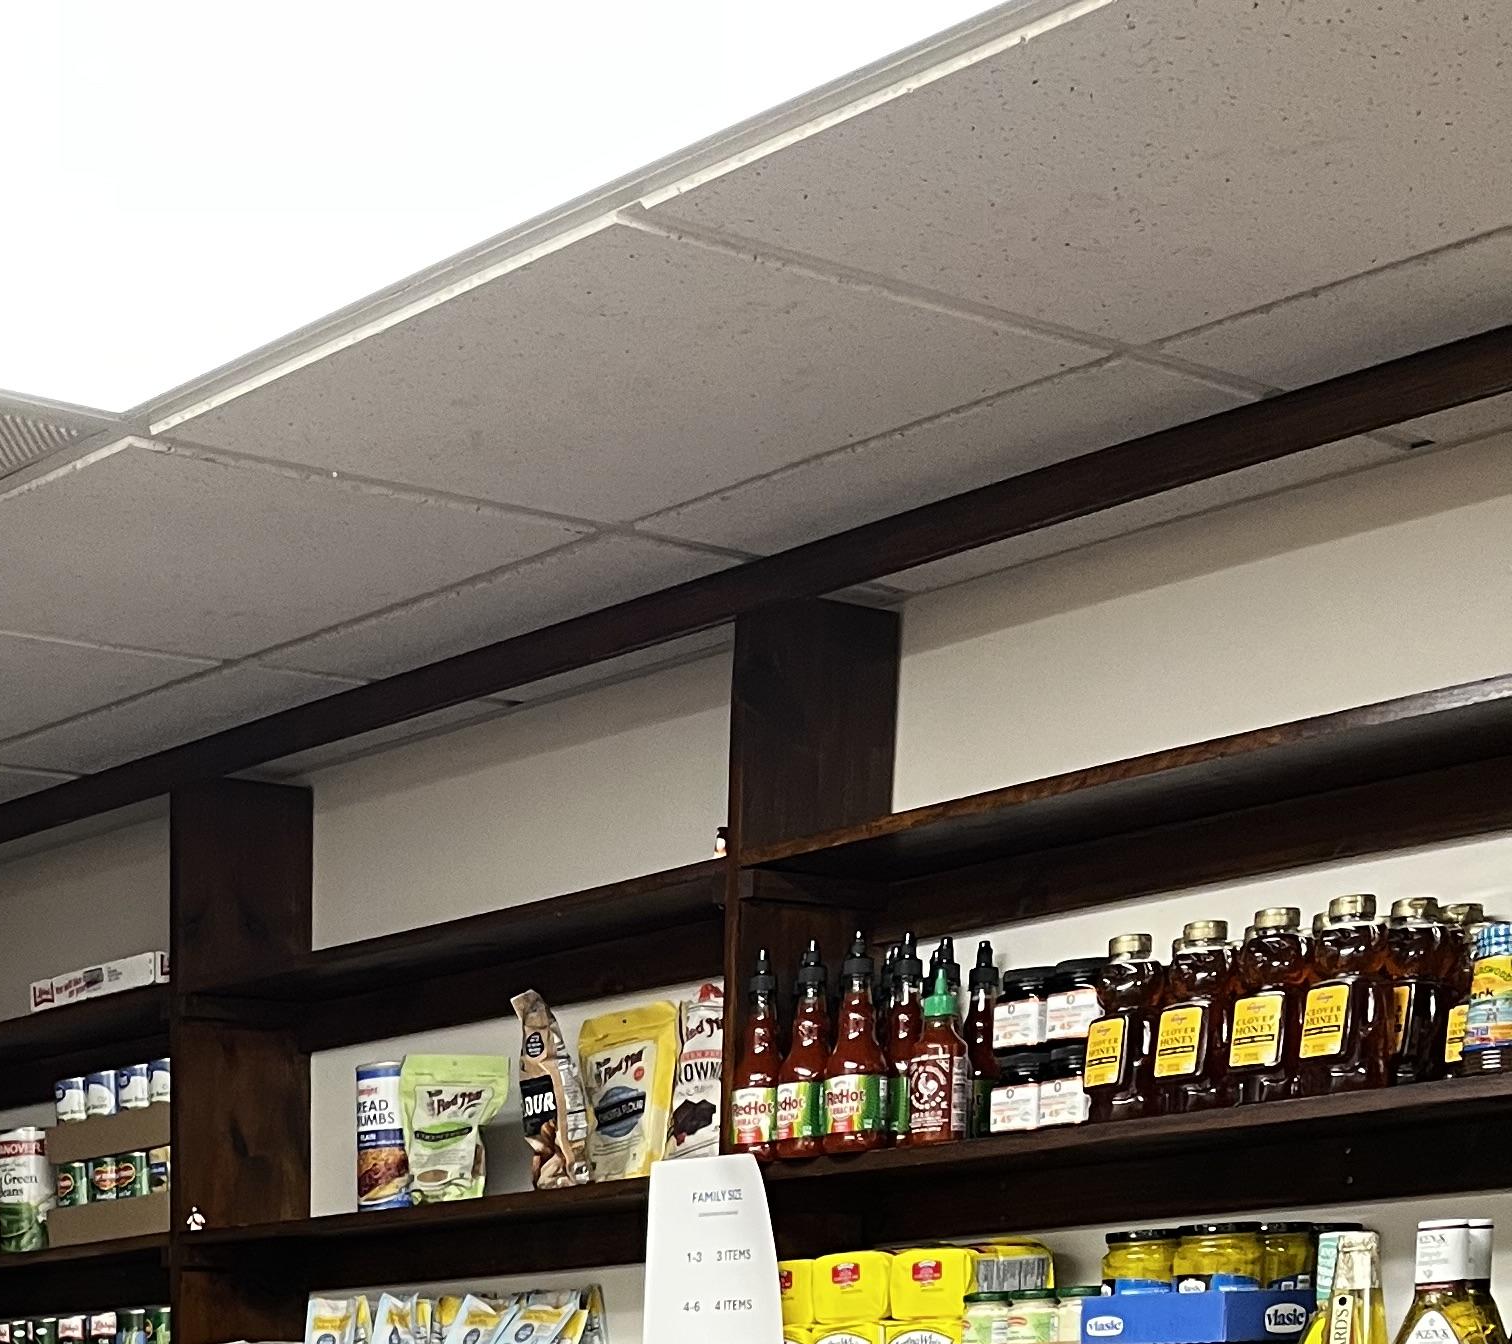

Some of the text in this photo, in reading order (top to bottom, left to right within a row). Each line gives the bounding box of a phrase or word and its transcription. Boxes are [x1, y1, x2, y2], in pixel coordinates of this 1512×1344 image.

[1307, 1006, 1342, 1017] CLOVER
[1236, 1014, 1275, 1026] CLOVER
[1305, 1014, 1339, 1026] HONEY
[1161, 1026, 1195, 1039] CLOVER
[1235, 1023, 1275, 1035] HONEY
[1090, 1037, 1118, 1047] CLOVER
[1160, 1034, 1195, 1047] HONEY
[1088, 1046, 1117, 1059] HONEY
[827, 1090, 866, 1104] RedHot
[732, 1101, 774, 1116] RedHot
[3, 1172, 39, 1188] Green
[692, 1189, 743, 1204] FAMILY SIZE
[687, 1249, 751, 1262] 1-3 3 ITEMS
[683, 1300, 752, 1312] 4-6 4 ITEMS
[1267, 1308, 1306, 1328] Vlasic
[1088, 1318, 1121, 1332] Vlasic
